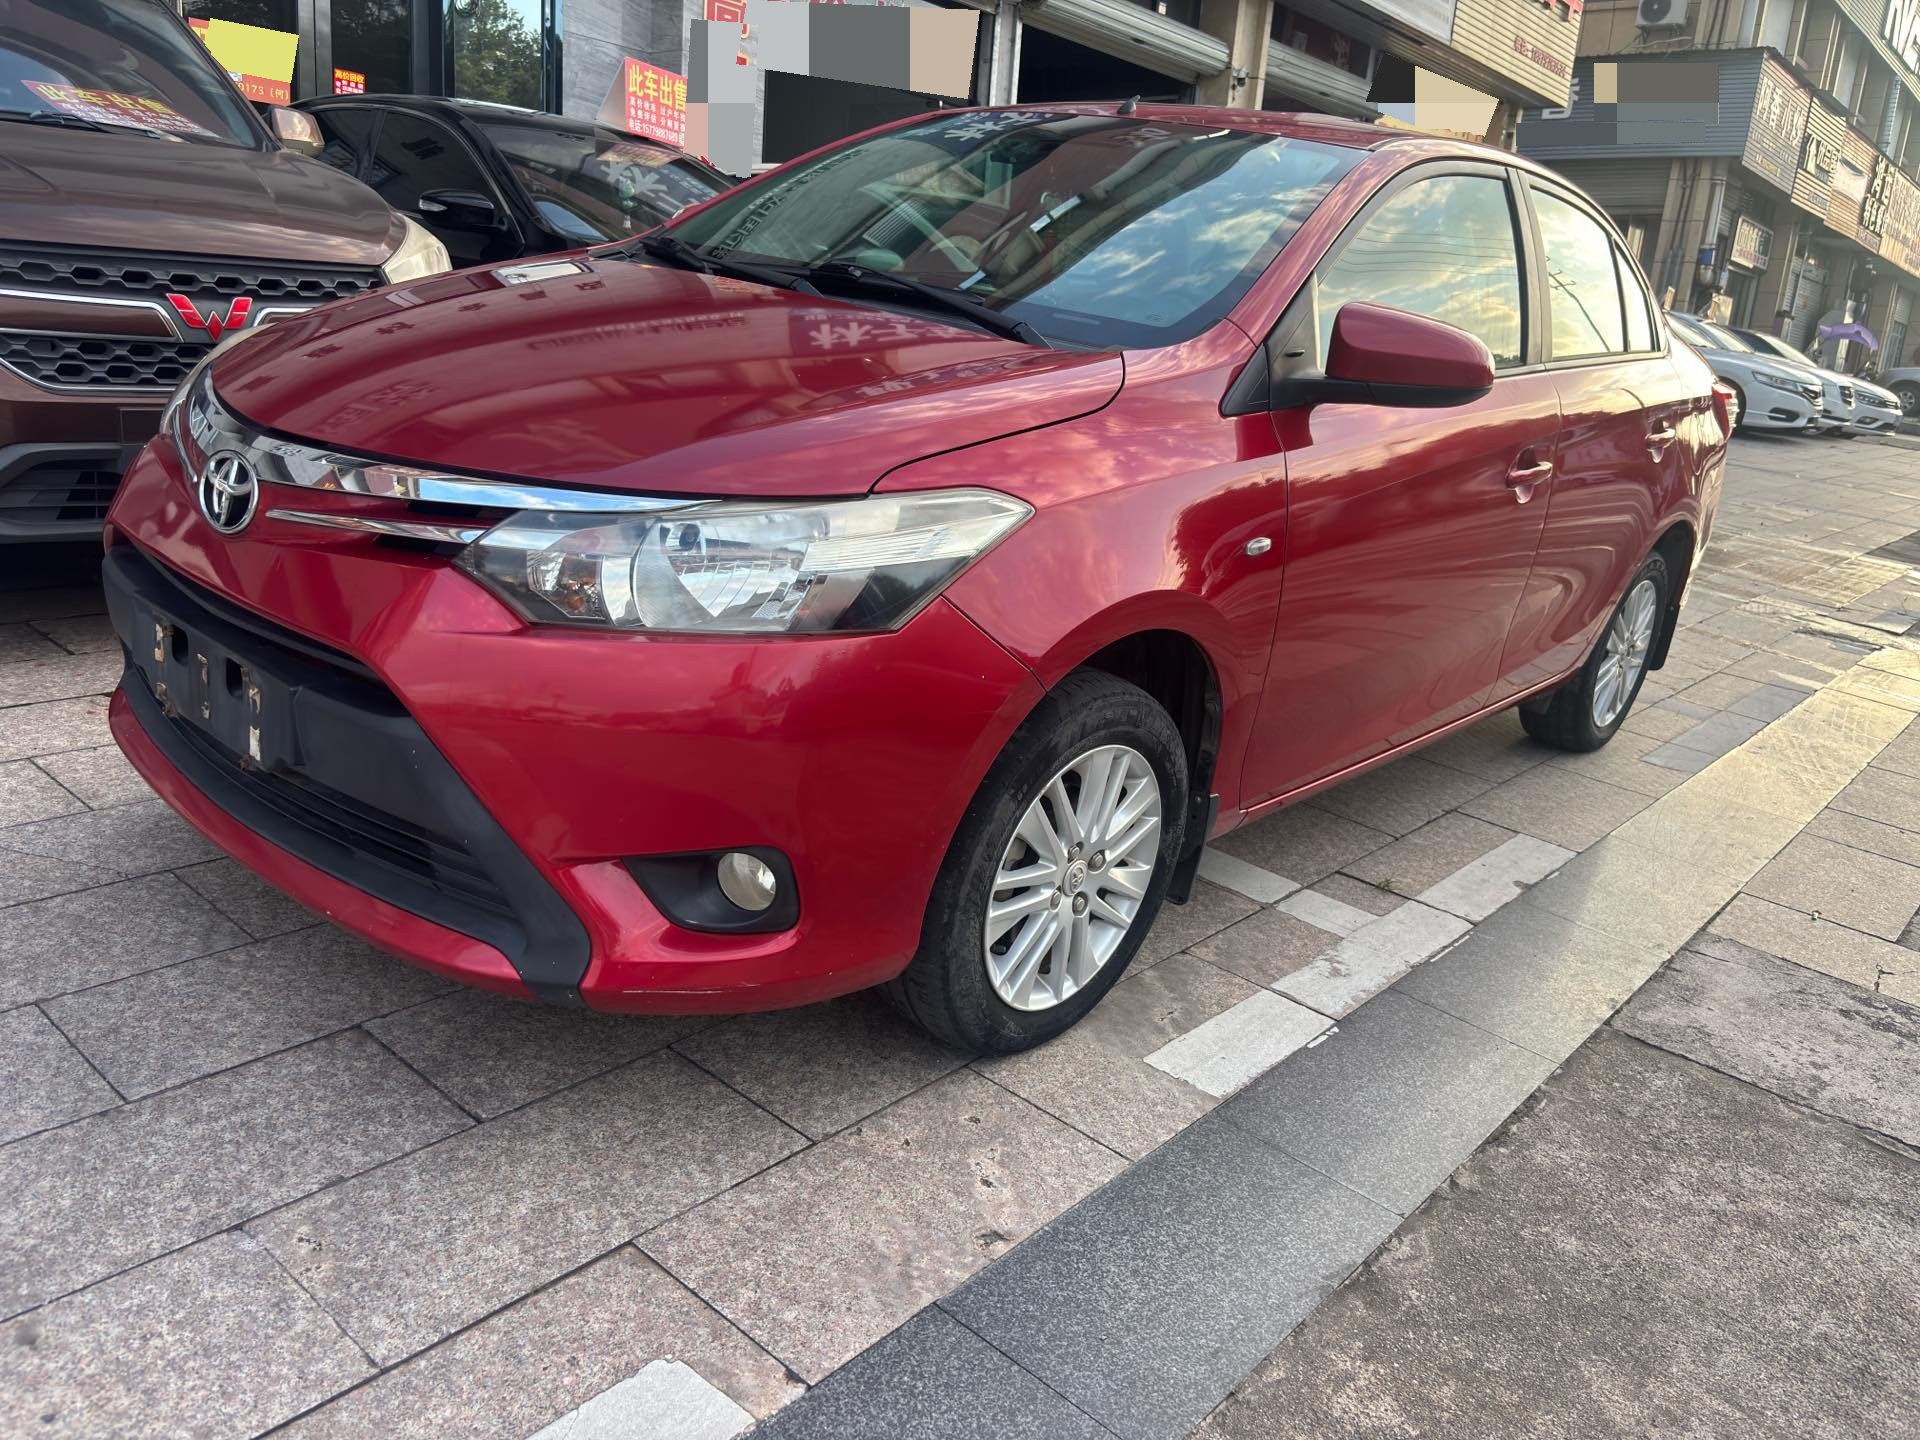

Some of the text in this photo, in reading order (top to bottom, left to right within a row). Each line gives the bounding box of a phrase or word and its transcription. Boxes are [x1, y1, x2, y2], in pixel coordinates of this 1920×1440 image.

[36, 84, 175, 114] 此车出售
[629, 64, 687, 113] 此车出售
